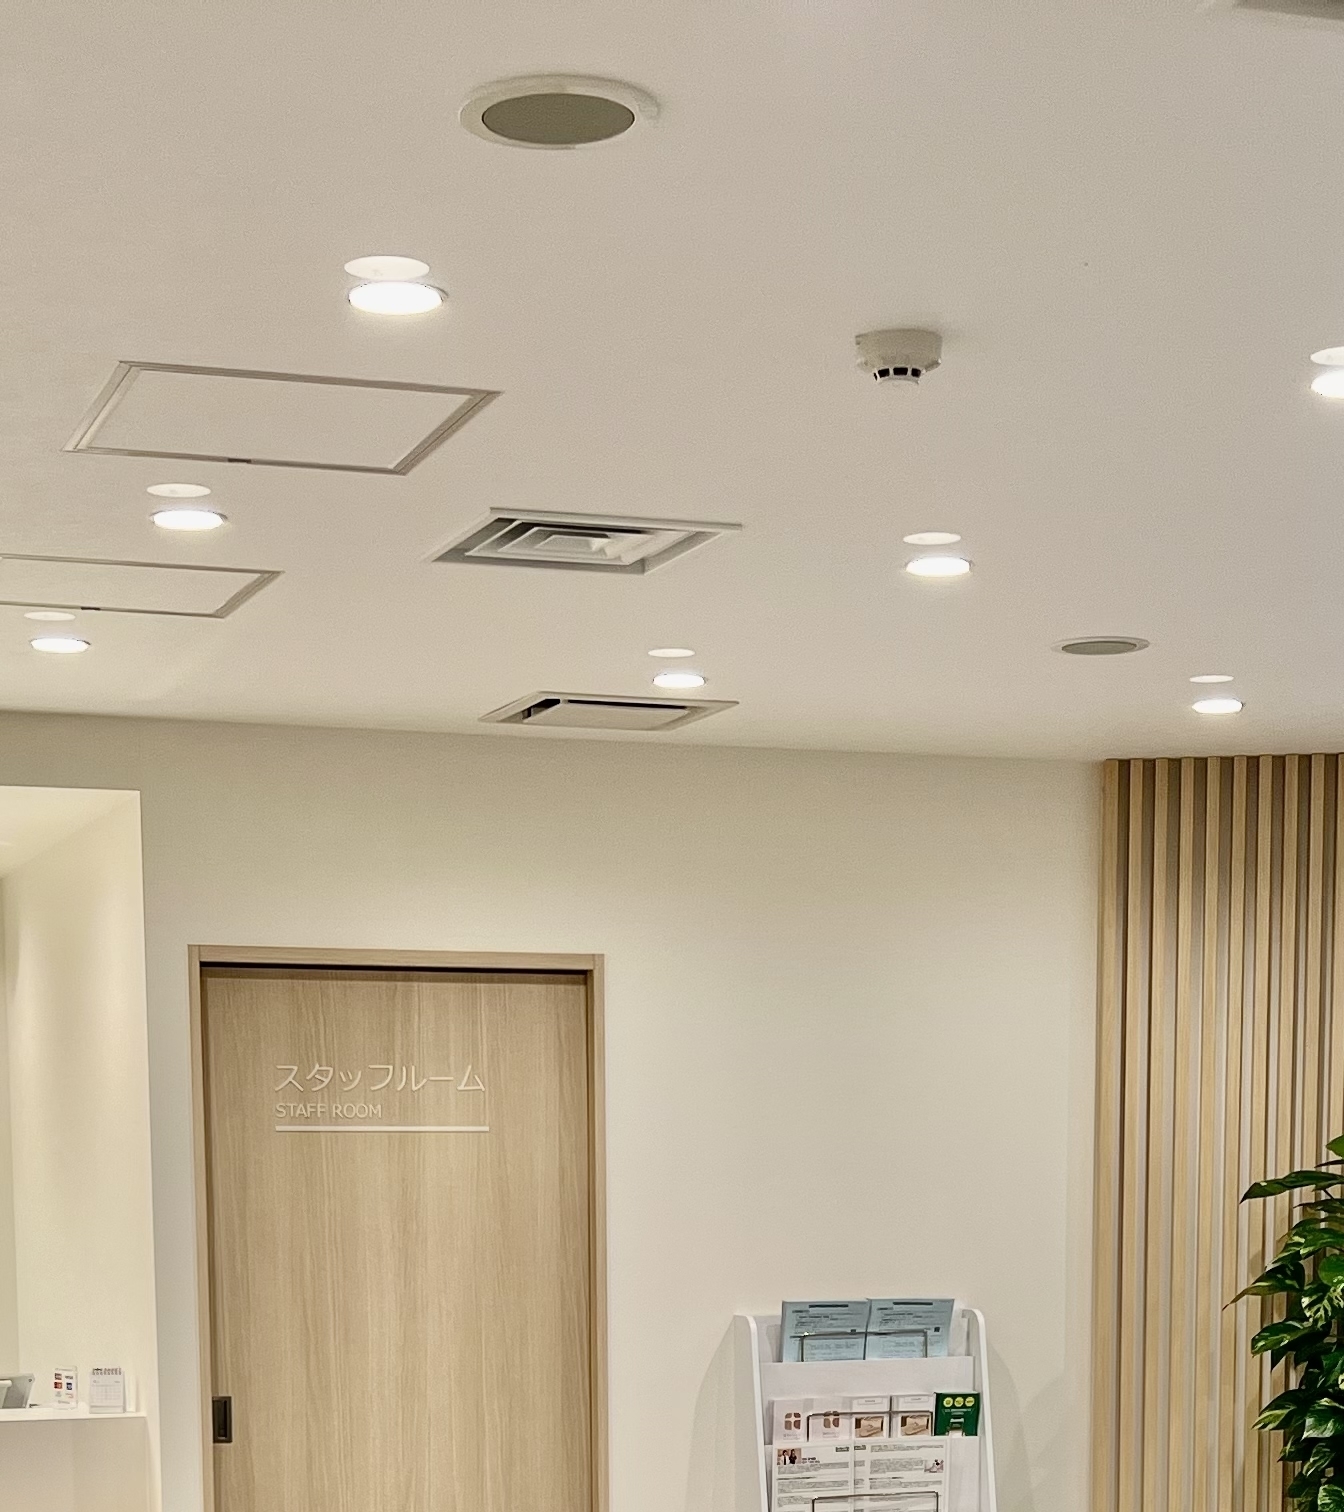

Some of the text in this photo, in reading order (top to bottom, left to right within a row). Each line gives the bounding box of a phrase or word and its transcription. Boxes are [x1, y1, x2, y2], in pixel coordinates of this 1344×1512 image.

[274, 1063, 486, 1092] スタッフルーム
[274, 1102, 382, 1119] STAFF ROOM
